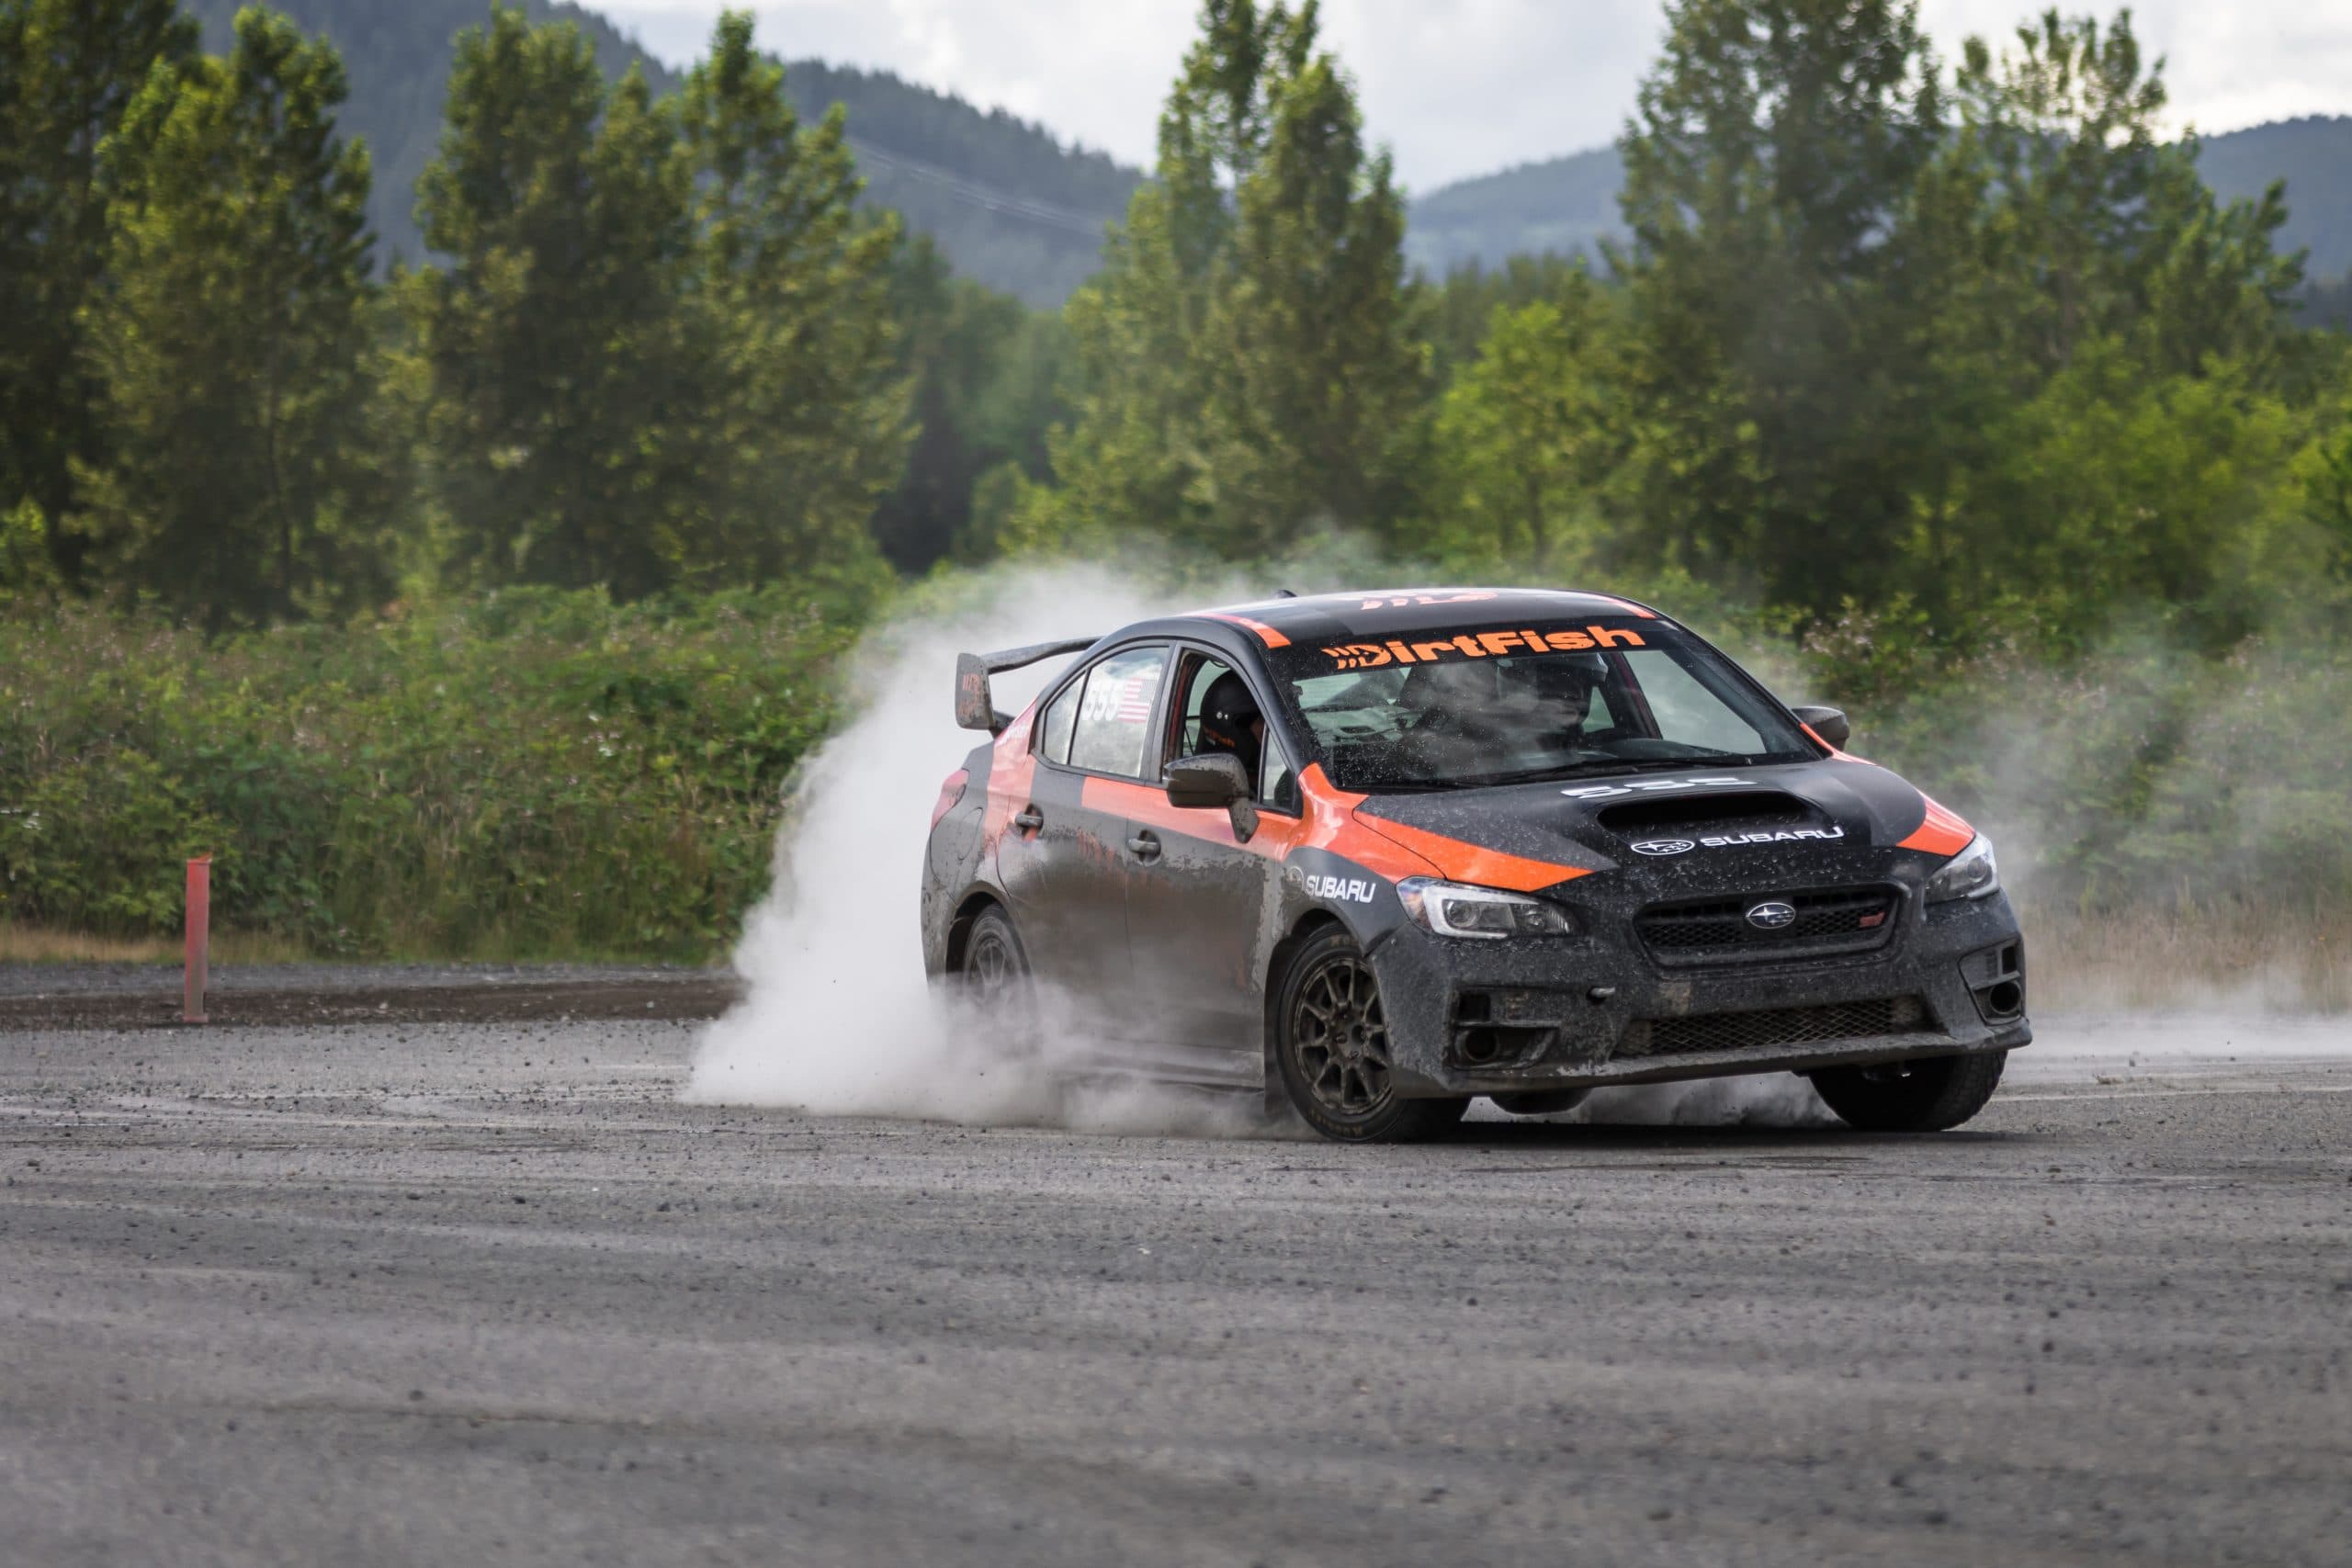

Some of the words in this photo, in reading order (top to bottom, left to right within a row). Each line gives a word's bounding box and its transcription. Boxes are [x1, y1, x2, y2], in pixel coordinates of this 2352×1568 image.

[1321, 626, 1646, 670] DirtFish
[1699, 826, 1845, 848] SUBARU
[1306, 874, 1376, 904] SUBARU
